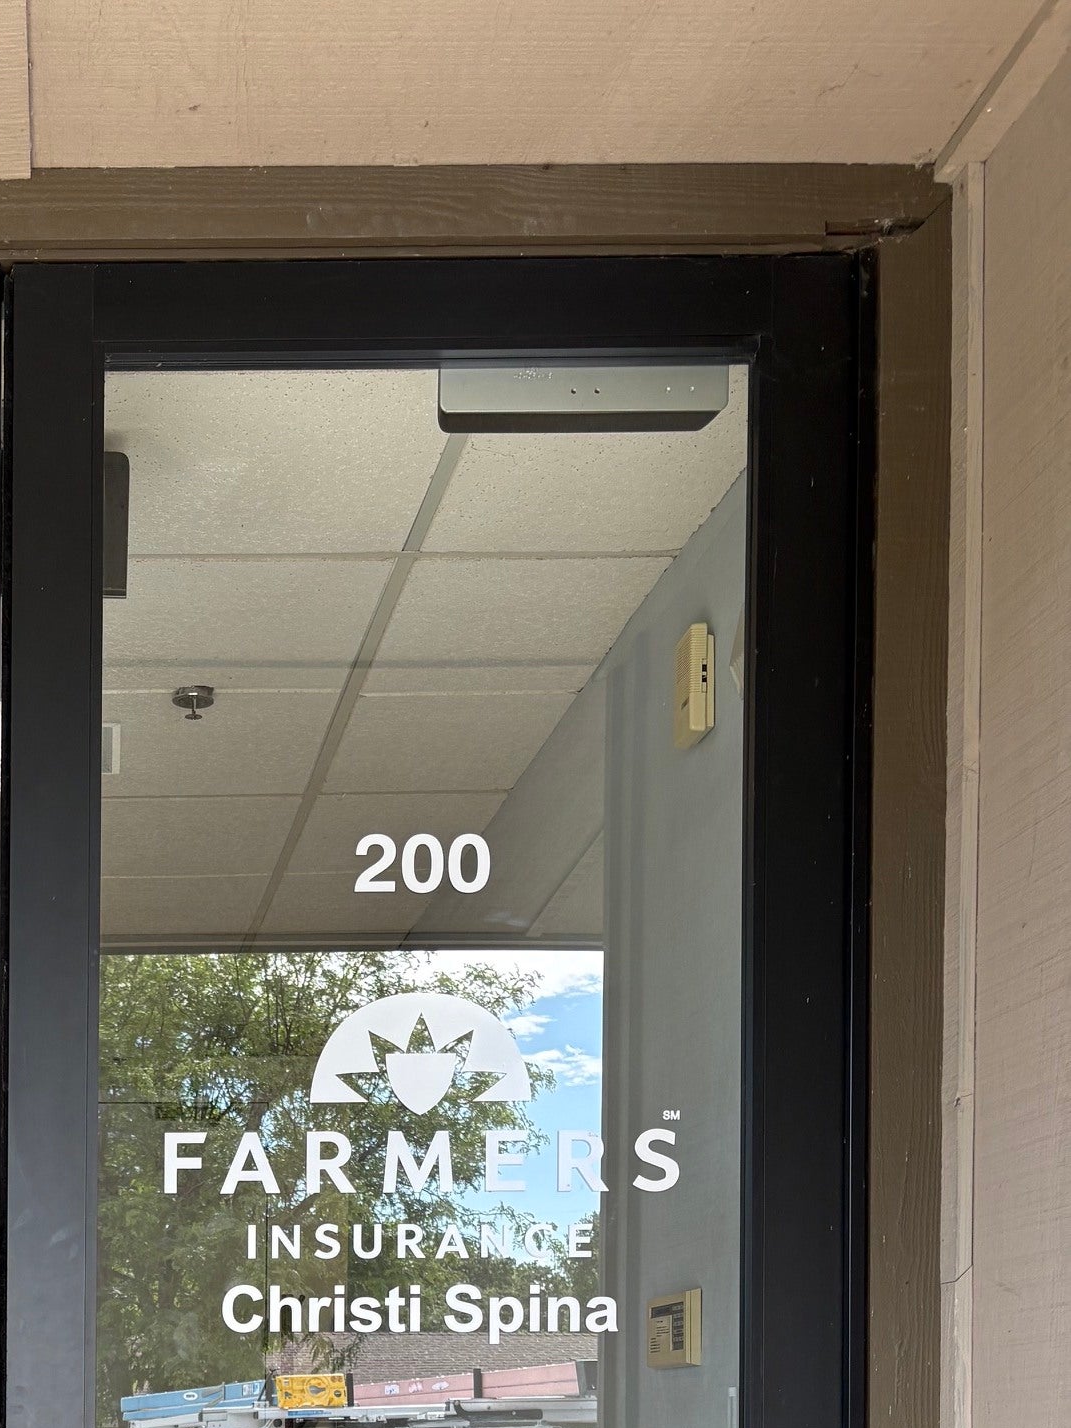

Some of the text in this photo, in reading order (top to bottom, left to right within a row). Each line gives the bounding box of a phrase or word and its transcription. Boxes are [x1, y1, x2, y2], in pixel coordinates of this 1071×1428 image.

[354, 833, 491, 893] 200
[662, 1110, 680, 1120] SM
[163, 1128, 680, 1195] FARMERS
[247, 1223, 593, 1260] INSURANCE
[221, 1284, 420, 1334] Christi
[444, 1285, 618, 1345] Spina
